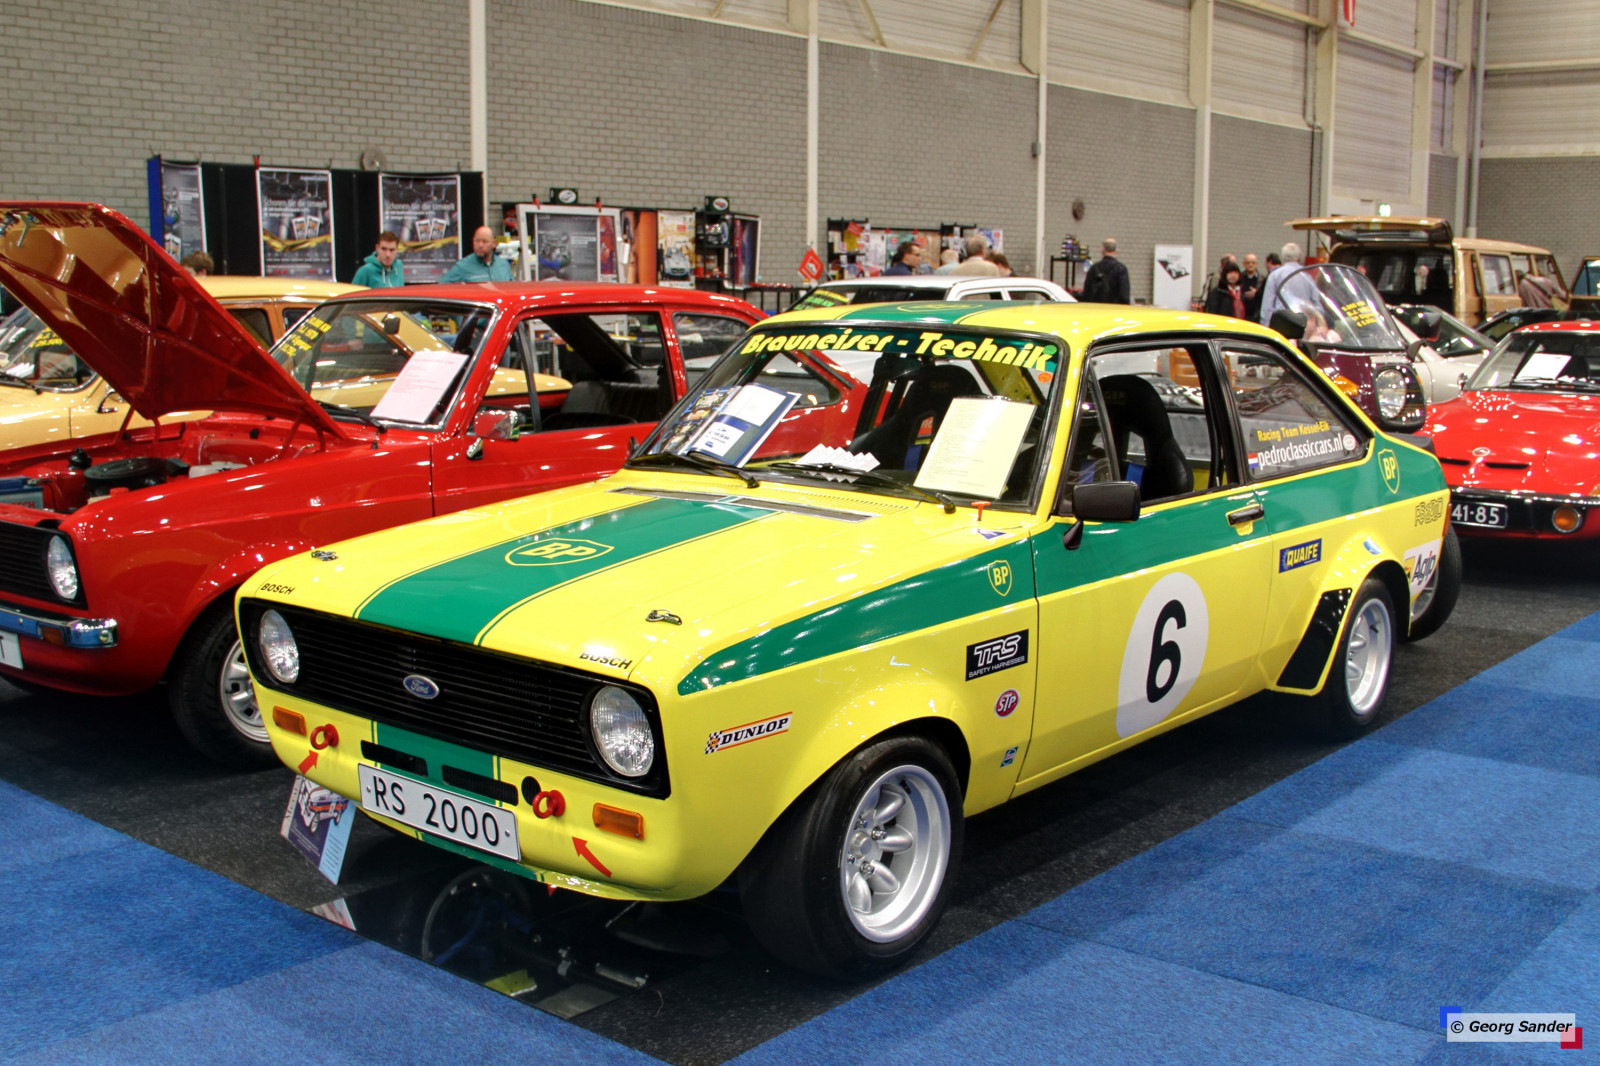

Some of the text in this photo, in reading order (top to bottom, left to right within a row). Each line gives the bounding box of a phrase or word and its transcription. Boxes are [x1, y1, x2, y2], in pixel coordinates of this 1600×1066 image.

[741, 327, 894, 355] Brauneiser
[915, 331, 1055, 371] Technik
[1257, 429, 1282, 442] Racing
[1280, 426, 1299, 438] Team
[1257, 433, 1344, 471] pedroclassiccars.nl
[1382, 456, 1396, 481] BP
[1451, 503, 1500, 525] 41-85
[517, 542, 597, 559] BP
[1286, 542, 1319, 566] QUAIFE
[992, 565, 1009, 586] BP
[1411, 550, 1436, 586] Agip
[260, 583, 296, 595] BOSCH
[973, 634, 1022, 667] TRS
[1146, 599, 1187, 703] 6
[968, 655, 1025, 678] SAFETY HARNESSES
[410, 679, 430, 694] Ford
[997, 693, 1017, 712] STP
[720, 717, 789, 745] DUNLOP
[373, 775, 500, 847] RS 2000
